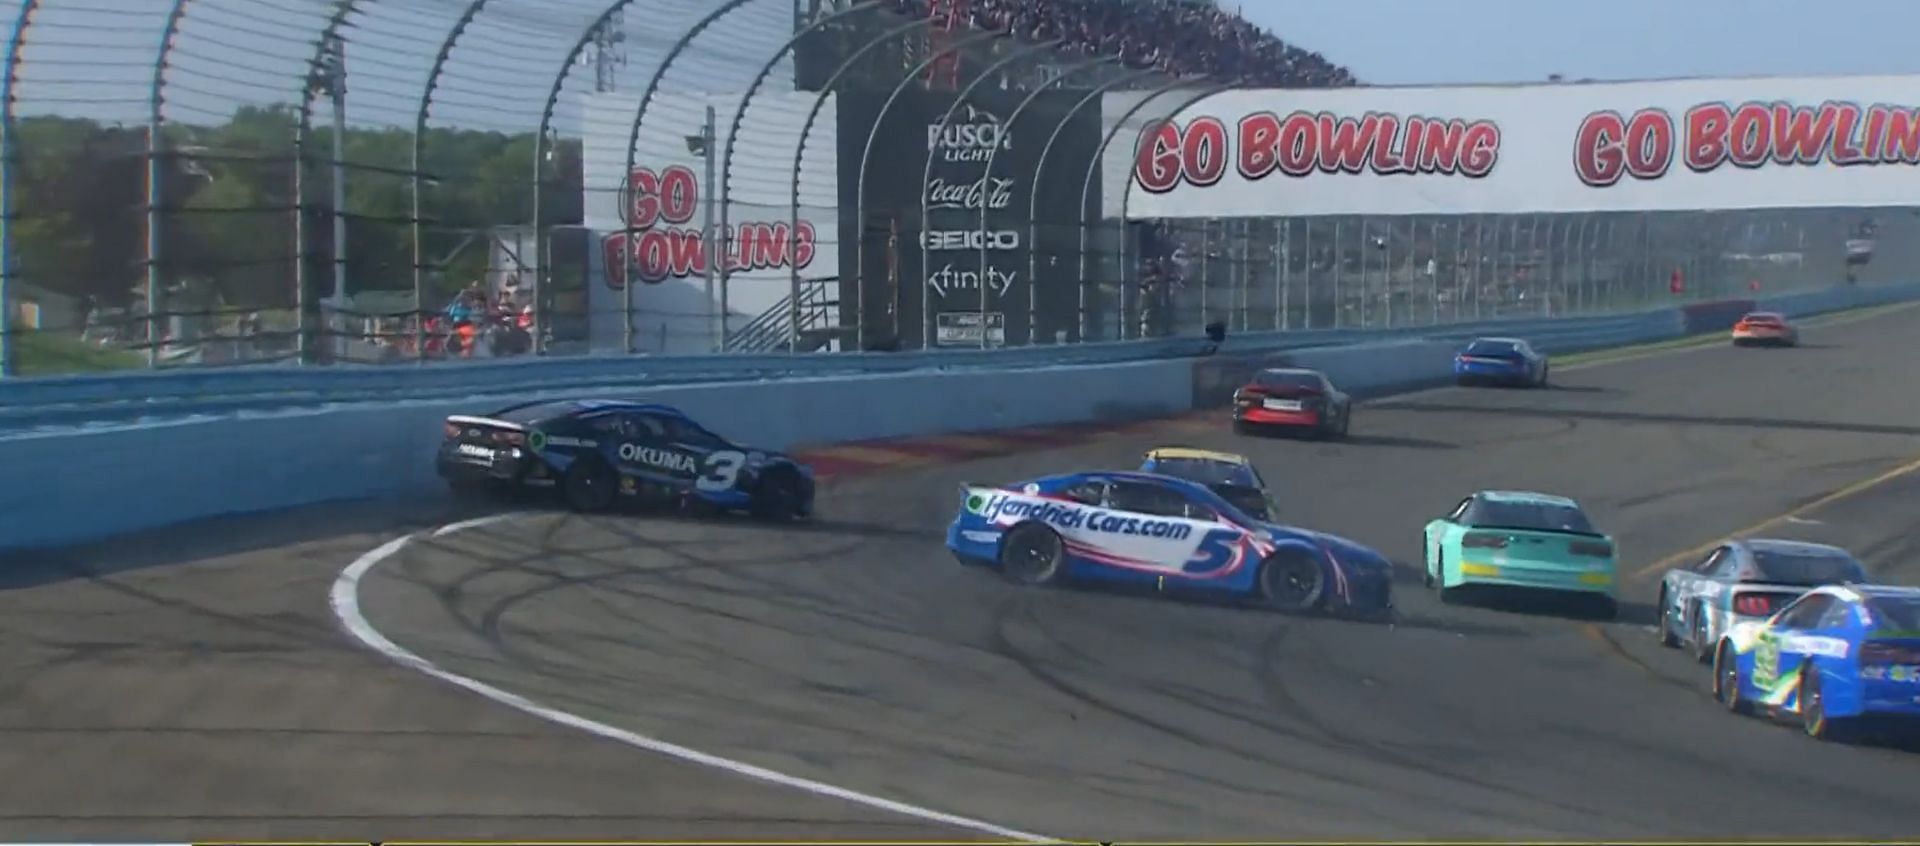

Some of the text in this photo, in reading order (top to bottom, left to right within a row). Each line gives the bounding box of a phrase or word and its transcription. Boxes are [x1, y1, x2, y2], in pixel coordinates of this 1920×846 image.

[1134, 110, 1500, 194] GO BOWLING
[1573, 108, 1675, 188] GO
[618, 165, 698, 229] GO
[920, 230, 1019, 250] GEICO
[620, 442, 697, 474] OKUMA
[696, 449, 746, 492] 3
[1182, 528, 1243, 574] 5
